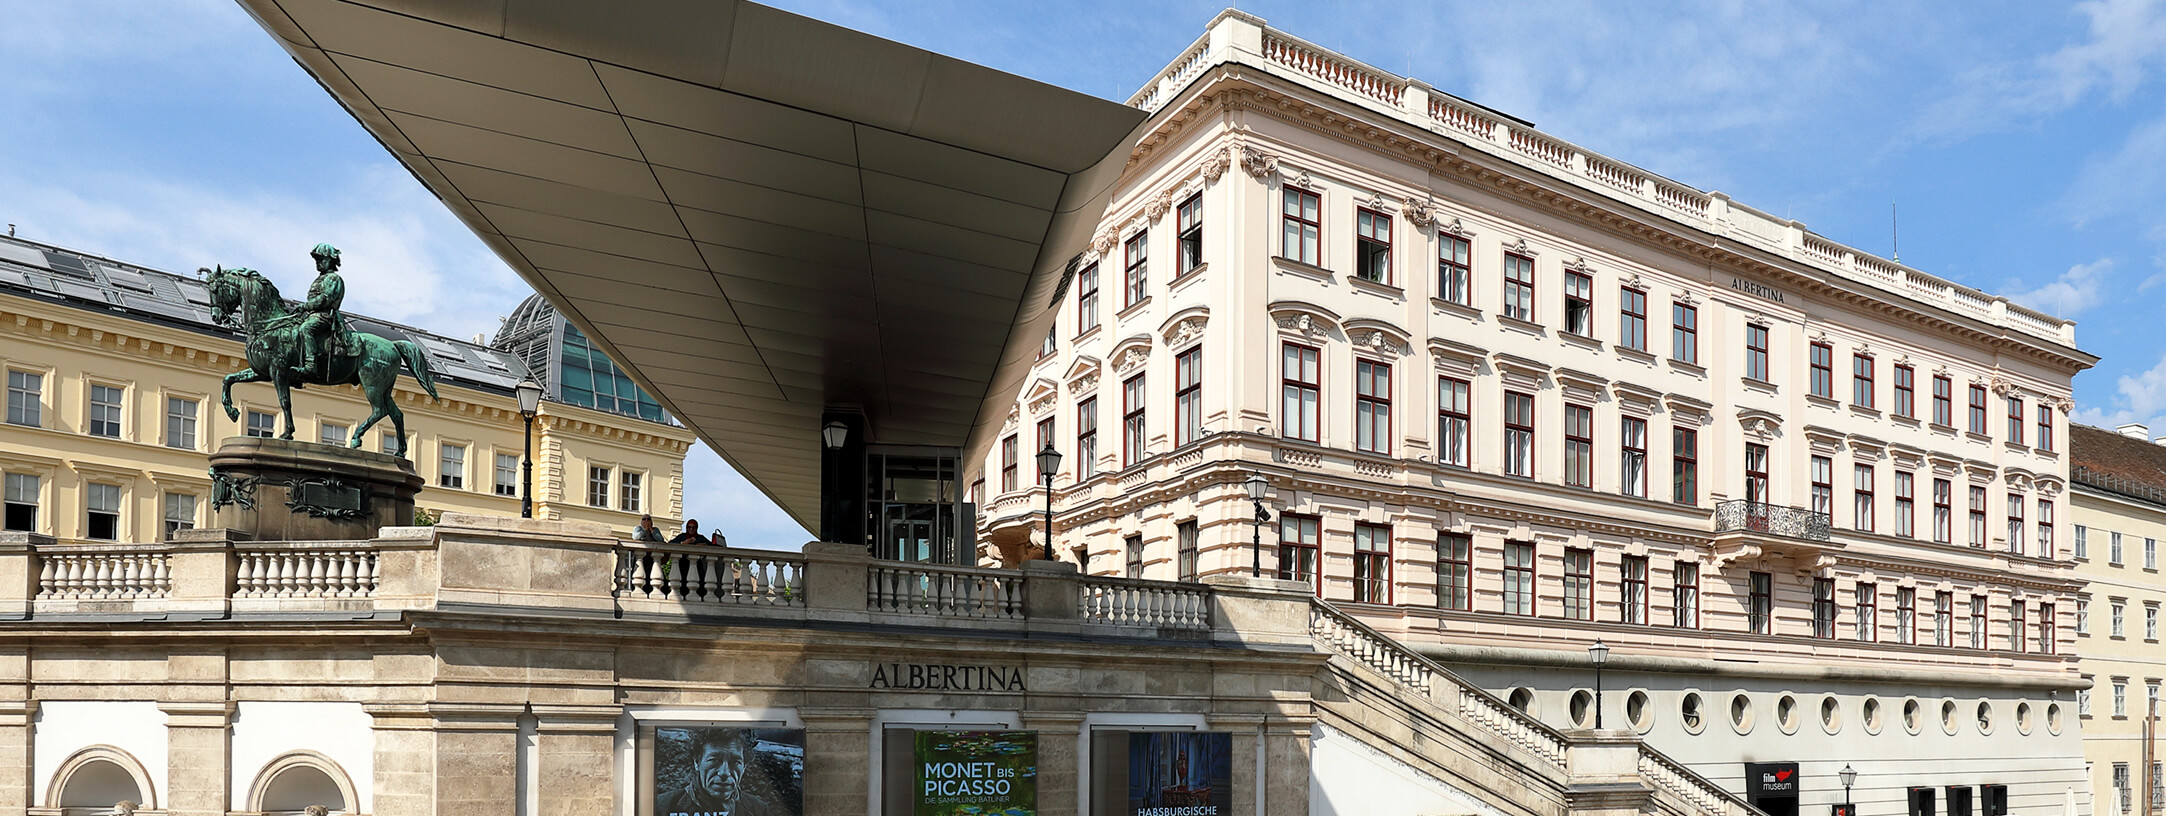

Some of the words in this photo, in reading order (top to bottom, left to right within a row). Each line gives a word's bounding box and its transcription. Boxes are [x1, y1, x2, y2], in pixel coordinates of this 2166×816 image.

[869, 663, 1027, 691] ALBERTINA
[925, 762, 995, 778] MONET
[997, 768, 1015, 778] BIS
[1763, 773, 1776, 782] film
[925, 780, 1011, 796] PICASSO
[978, 795, 1010, 803] BATLINER
[1137, 806, 1217, 816] HABSBURGISCHE
